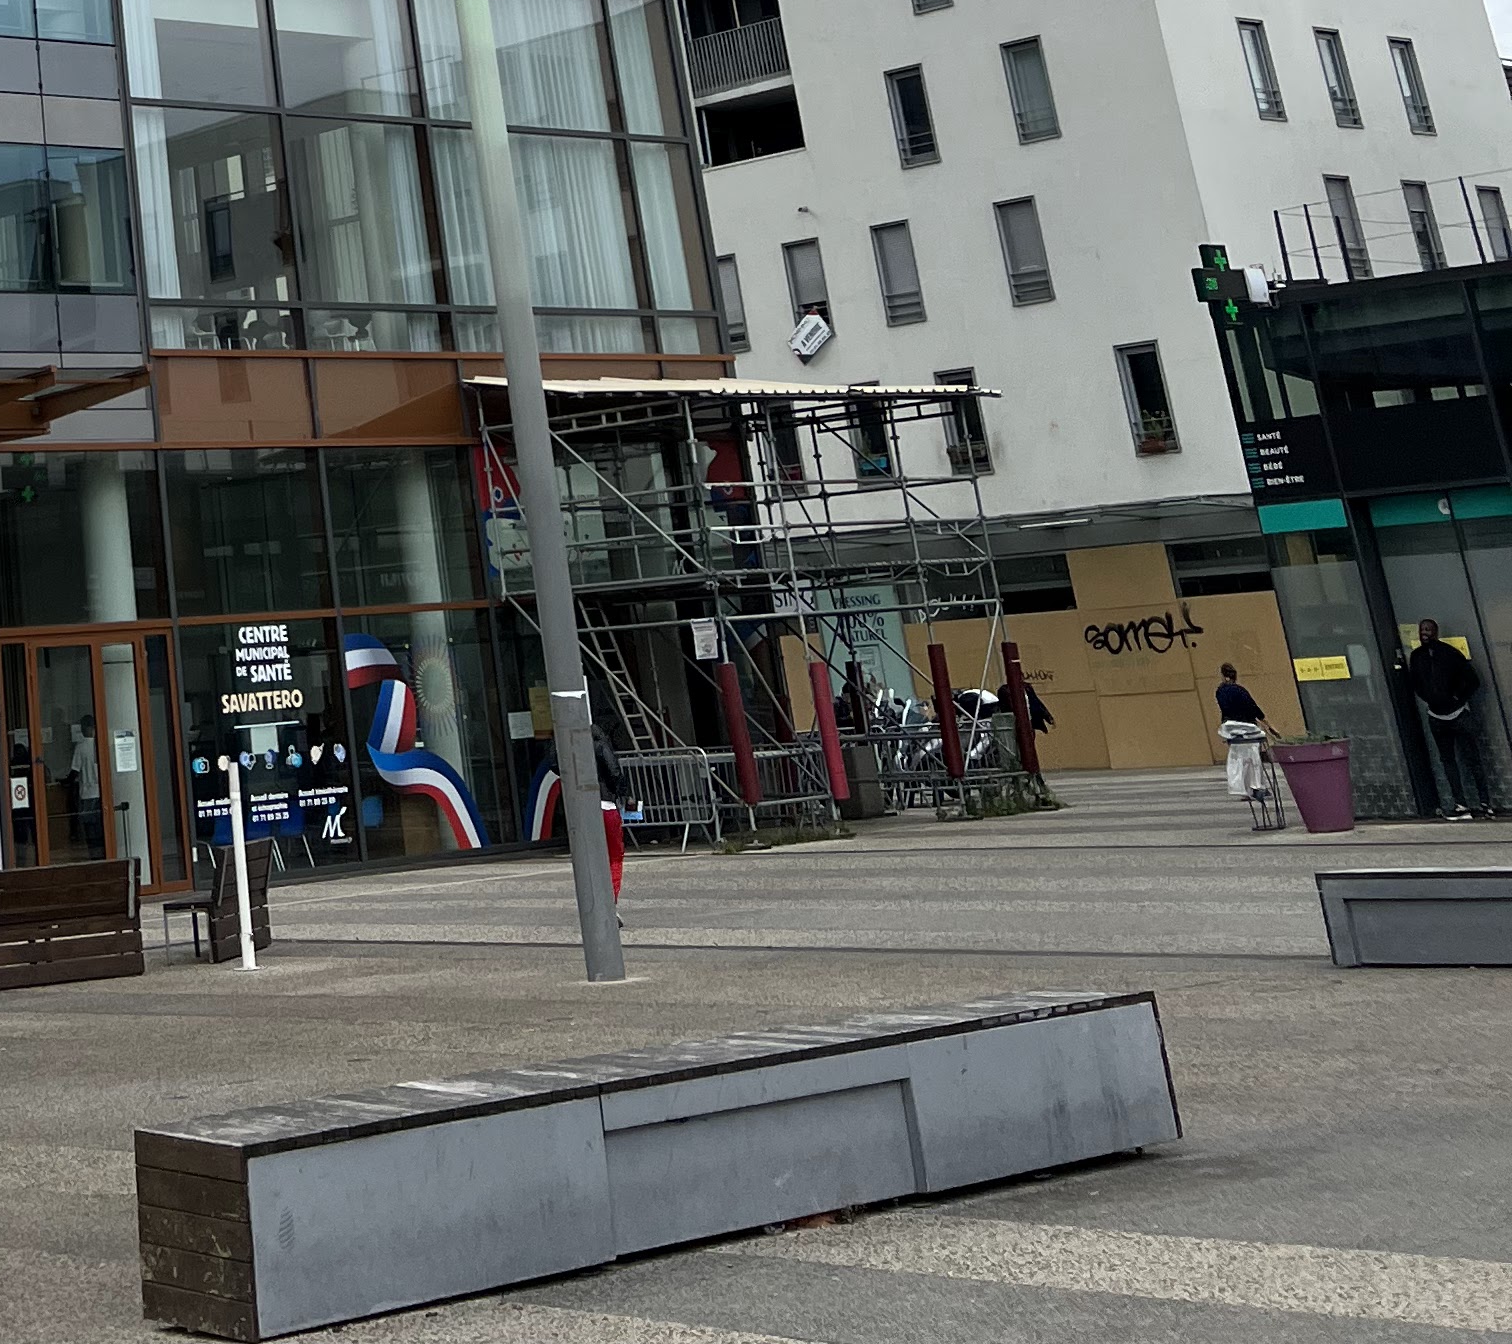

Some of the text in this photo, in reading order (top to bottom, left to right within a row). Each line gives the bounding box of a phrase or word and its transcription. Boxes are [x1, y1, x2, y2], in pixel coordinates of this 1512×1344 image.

[1257, 431, 1281, 441] SANTÉ
[1260, 445, 1289, 456] BEAUTÉ
[238, 625, 288, 644] CENTRE
[235, 646, 290, 661] MUNICIPAL
[235, 659, 292, 683] DE SANTÉ
[221, 689, 303, 714] SAVATTERO
